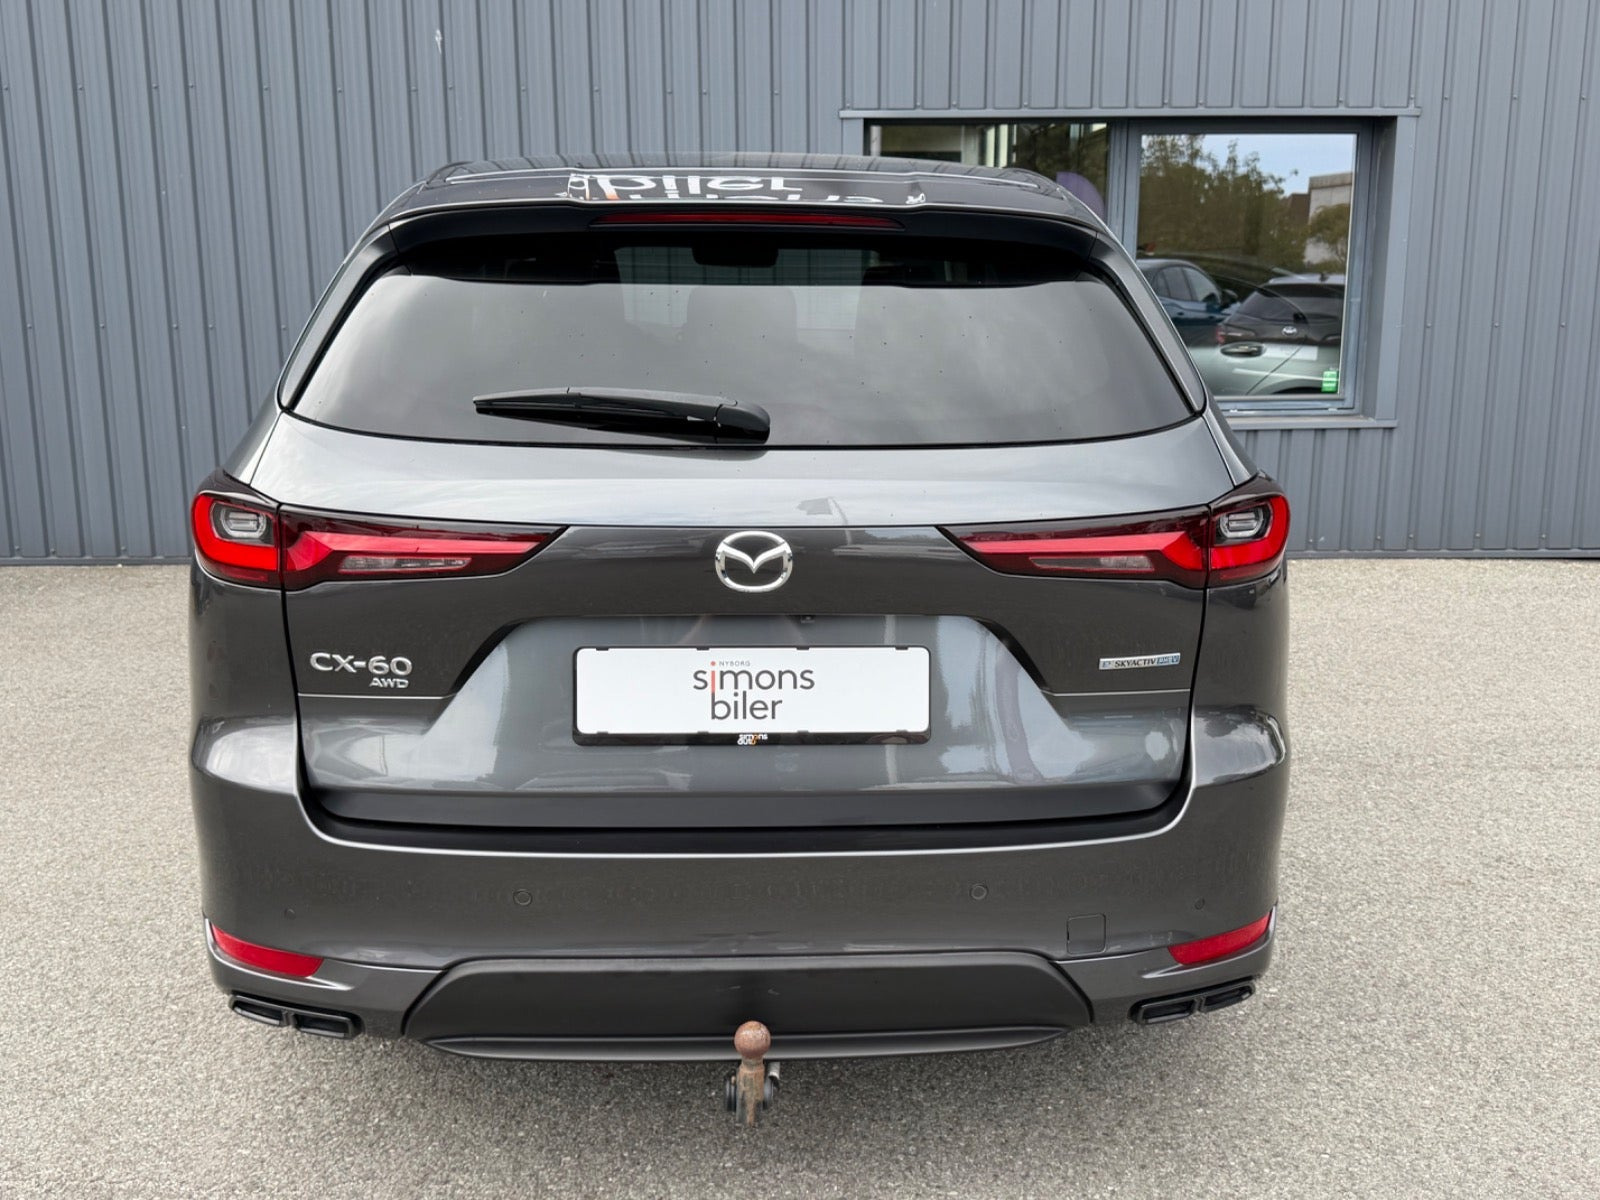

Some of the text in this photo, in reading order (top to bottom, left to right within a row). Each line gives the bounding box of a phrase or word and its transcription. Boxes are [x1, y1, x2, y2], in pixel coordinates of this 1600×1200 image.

[310, 652, 413, 676] CX-60
[692, 660, 816, 692] simons
[718, 660, 751, 668] NYBORG
[369, 677, 410, 689] AWD
[711, 690, 783, 721] biler
